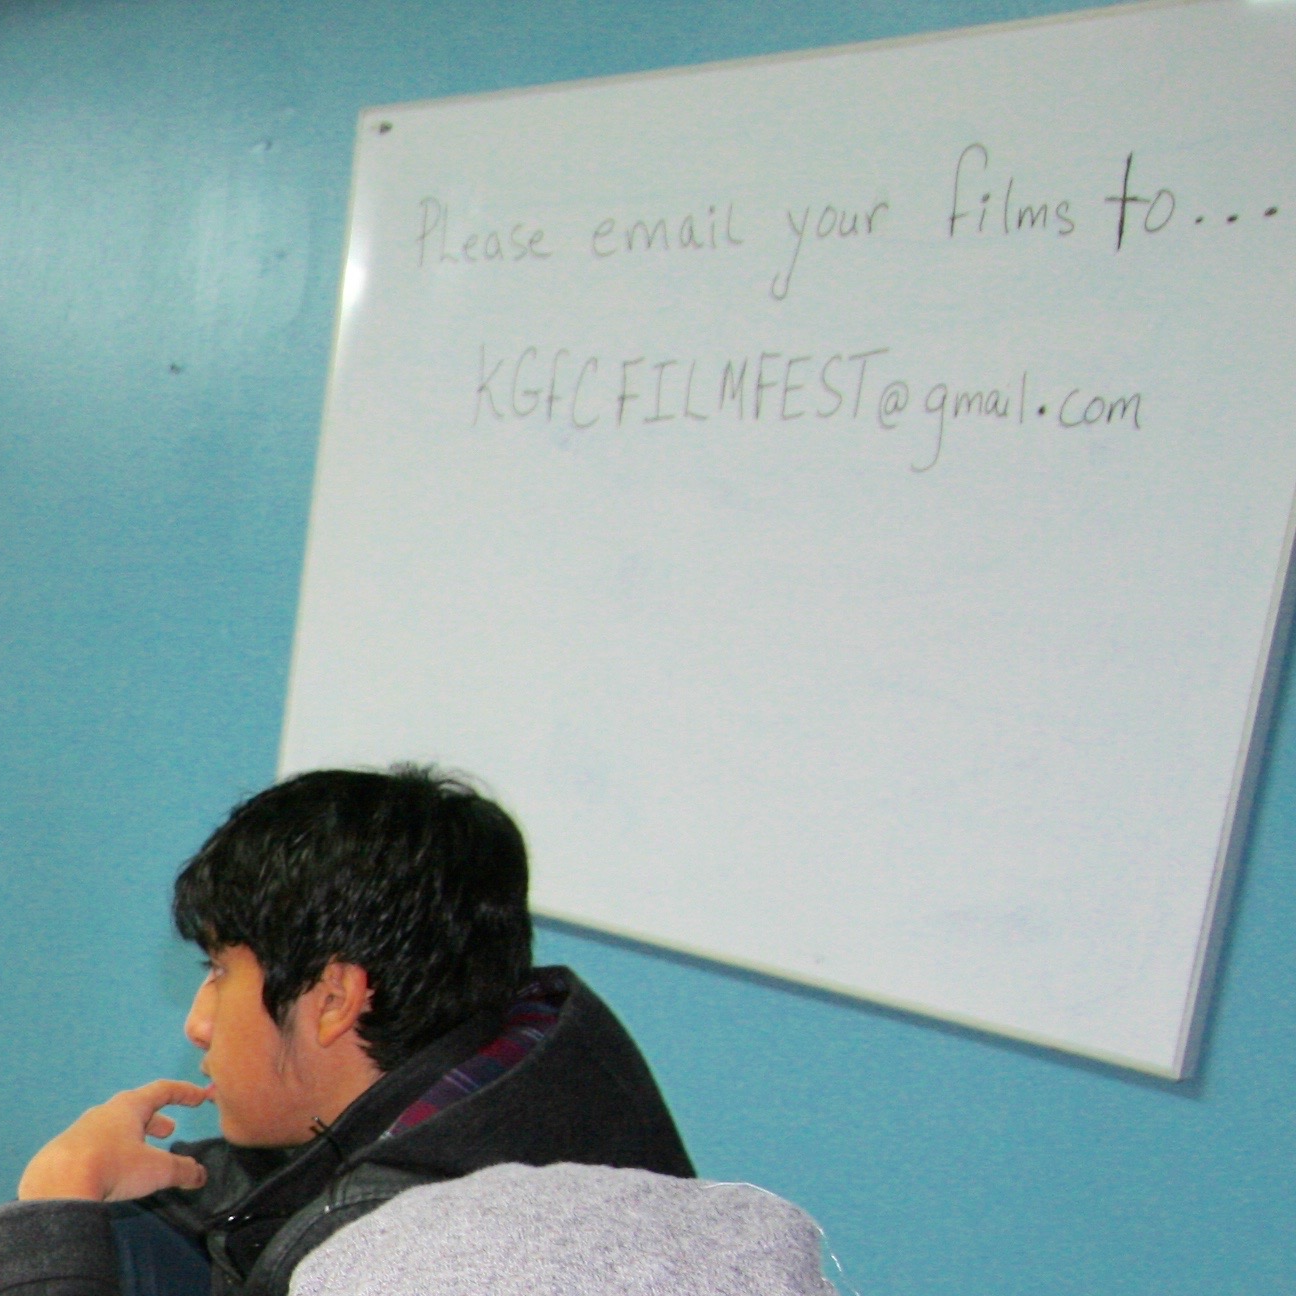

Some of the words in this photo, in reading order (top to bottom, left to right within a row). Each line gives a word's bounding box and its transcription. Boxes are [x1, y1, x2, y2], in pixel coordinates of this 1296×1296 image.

[592, 203, 744, 257] email
[769, 199, 890, 300] your
[947, 143, 1076, 238] films
